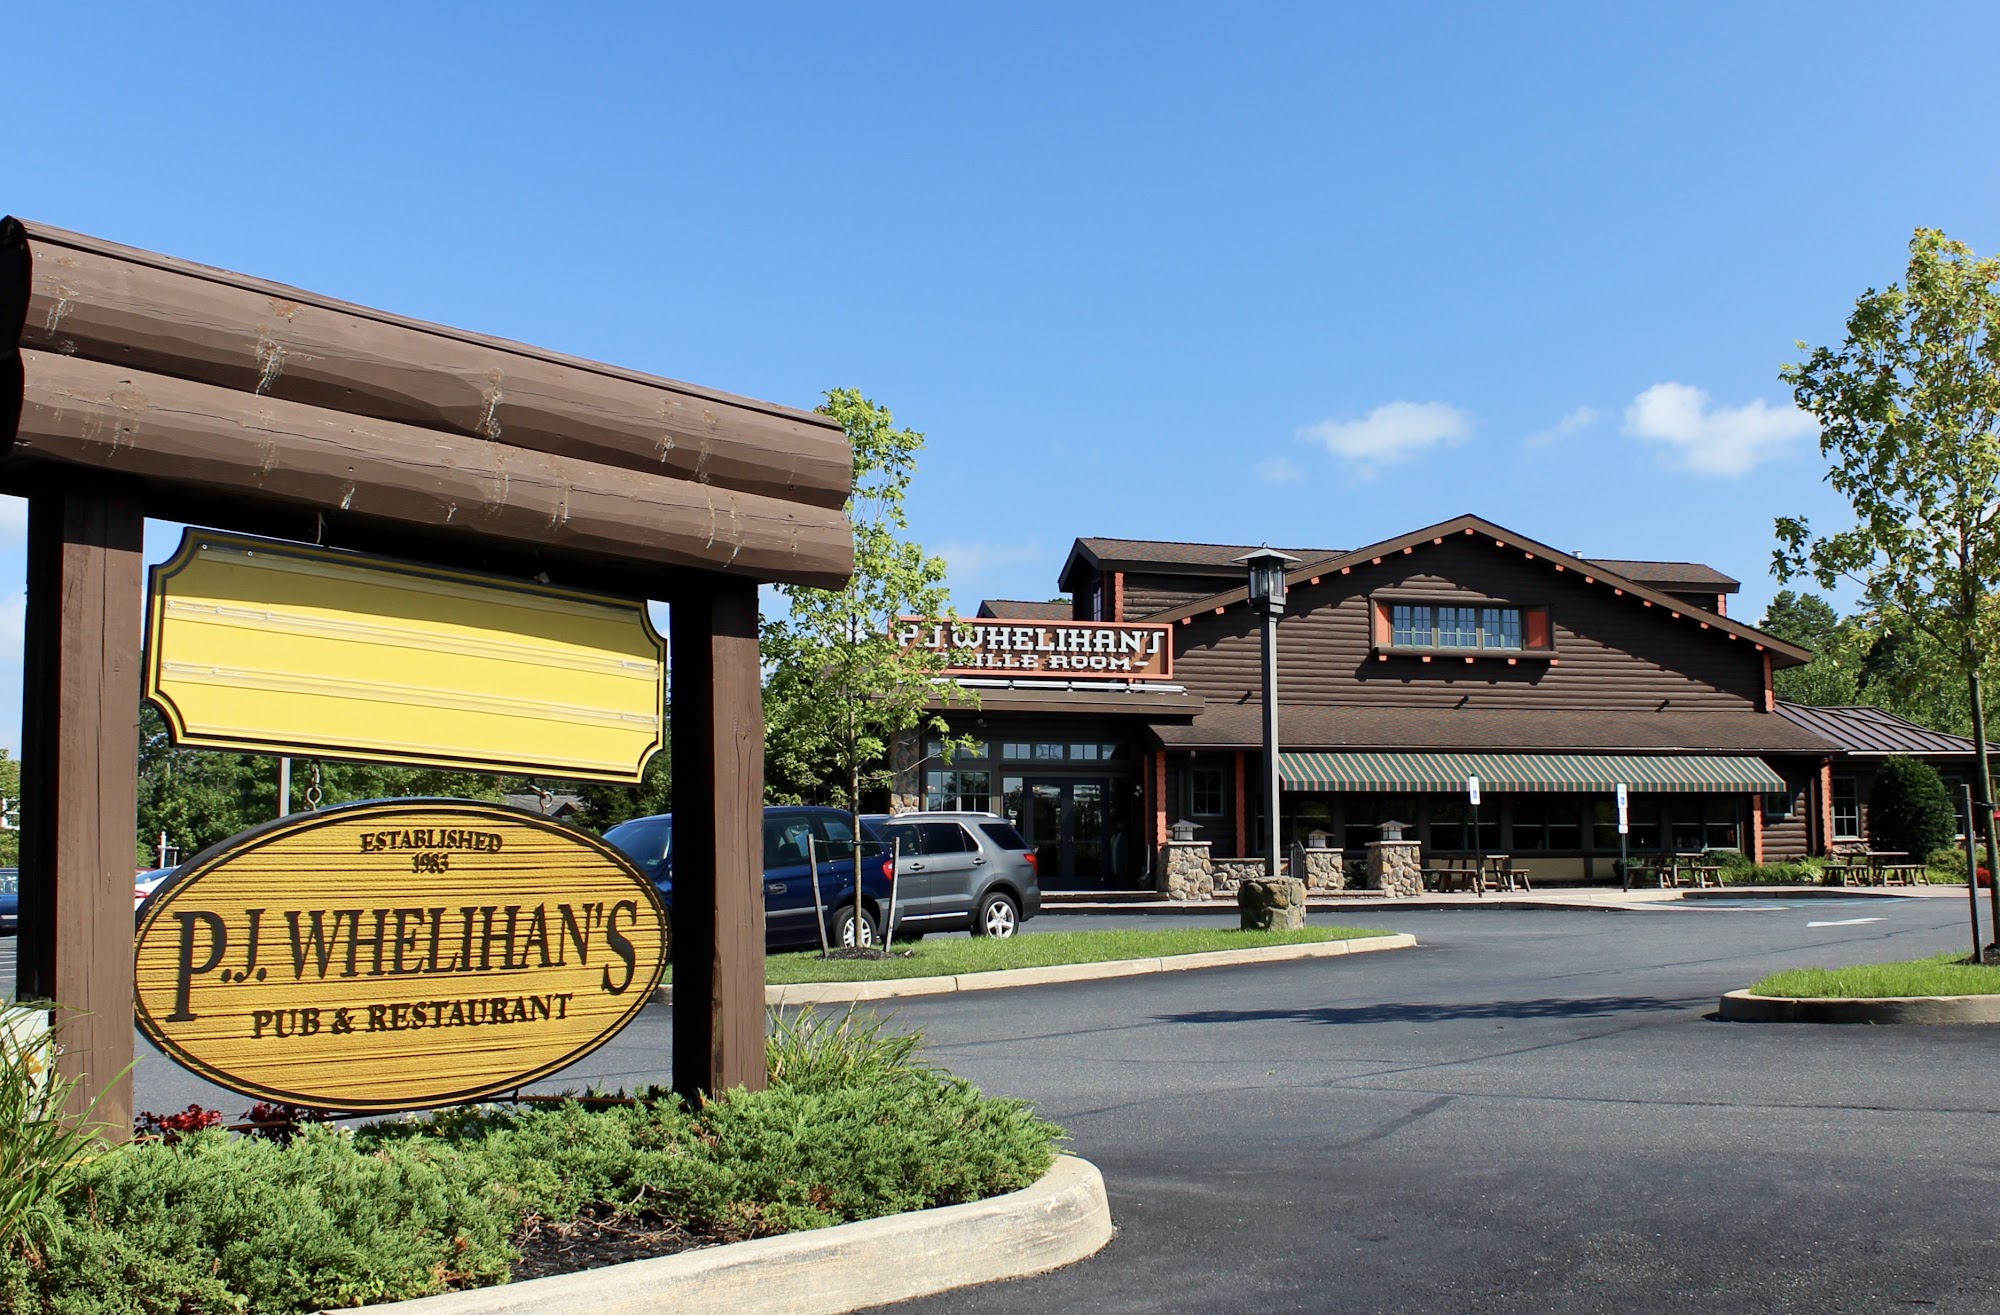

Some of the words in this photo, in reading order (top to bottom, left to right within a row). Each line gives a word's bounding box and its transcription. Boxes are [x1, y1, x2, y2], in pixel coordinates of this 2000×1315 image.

[951, 625, 1165, 654] WHELIHAN'S
[360, 829, 503, 853] ESTABLISHED
[411, 853, 449, 874] 1983
[165, 908, 267, 1023] P.J.
[284, 900, 637, 996] WHELIHAN'S
[251, 1008, 321, 1039] PUB
[331, 1007, 356, 1035] &
[366, 993, 573, 1032] RESTAURANT
